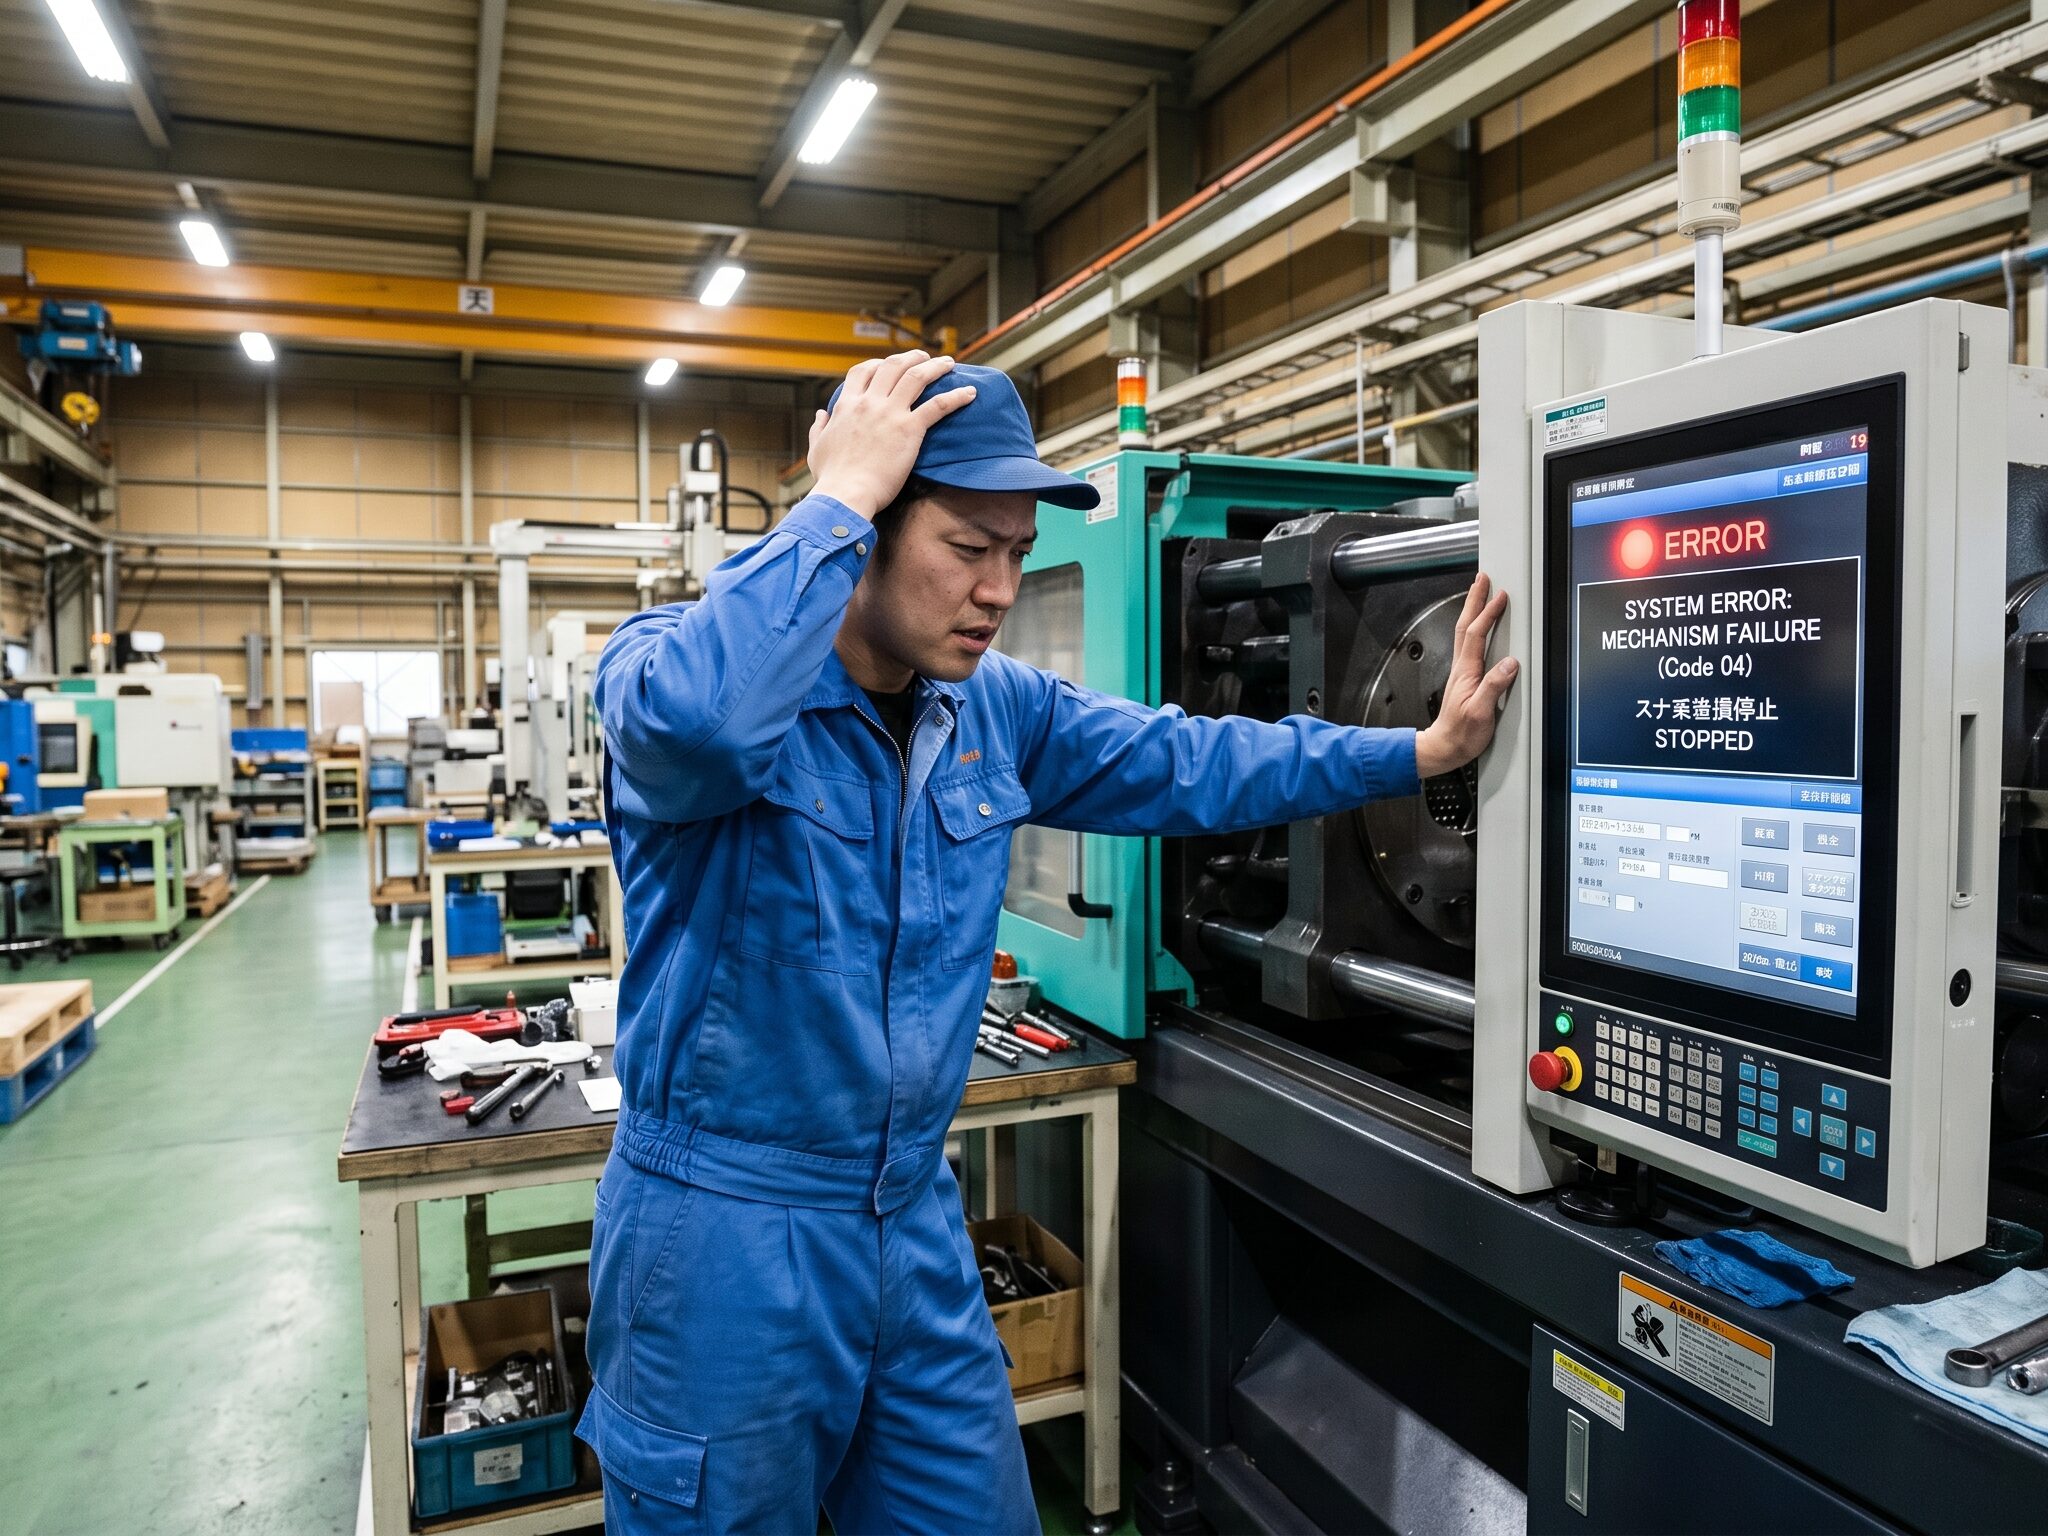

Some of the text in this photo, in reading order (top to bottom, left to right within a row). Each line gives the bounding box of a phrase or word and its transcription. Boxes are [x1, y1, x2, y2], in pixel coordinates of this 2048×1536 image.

[1850, 434, 1867, 449] 19
[1664, 520, 1766, 561] ERROR
[1625, 587, 1792, 620] SYSTEM ERROR:
[1601, 618, 1821, 651] MECHANISM FAILURE
[1658, 652, 1753, 680] (Code 04)
[1655, 728, 1754, 751] STOPPED
